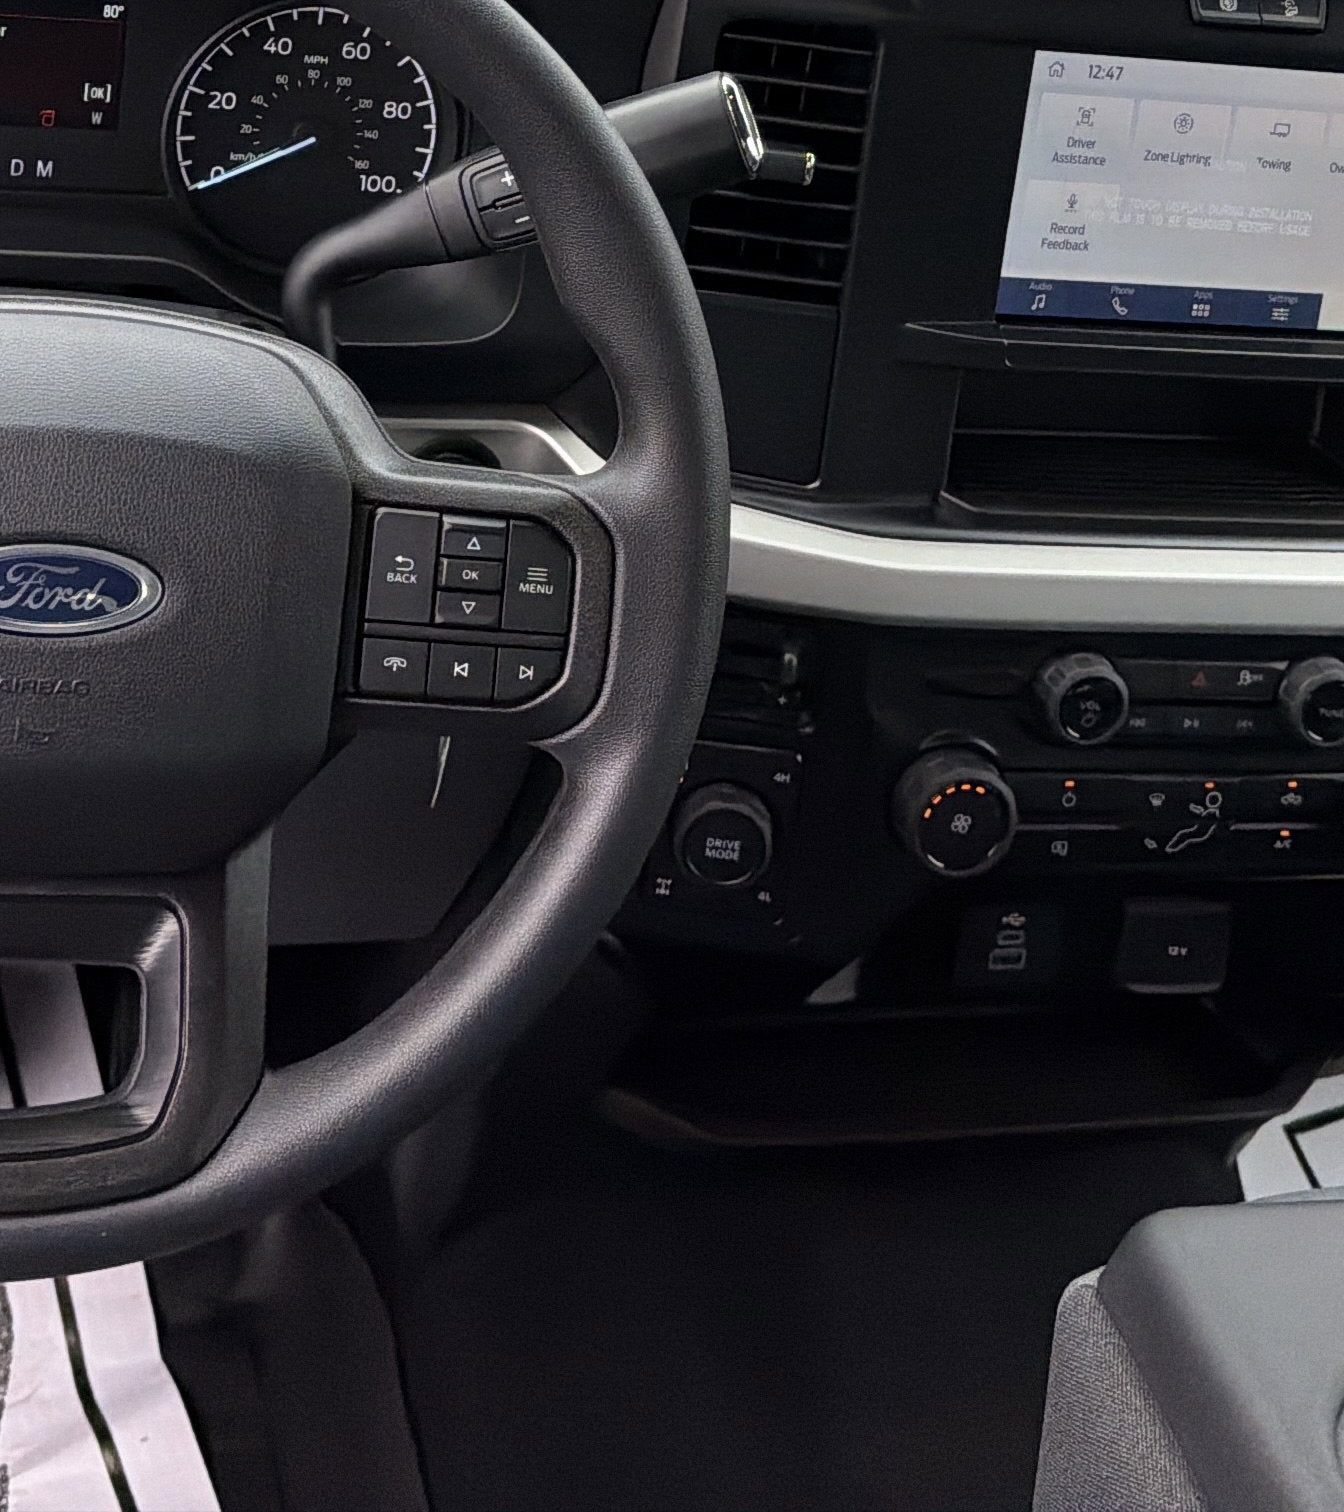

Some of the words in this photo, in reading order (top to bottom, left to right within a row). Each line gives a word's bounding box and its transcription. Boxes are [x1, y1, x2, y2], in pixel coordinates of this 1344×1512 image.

[262, 38, 294, 57] 40
[341, 42, 372, 61] 60
[303, 54, 330, 66] MPH
[307, 68, 321, 80] 80
[1087, 63, 1124, 81] 12:47
[275, 74, 289, 86] 60
[335, 75, 353, 88] 100
[207, 91, 237, 110] 20
[250, 94, 265, 106] 40
[358, 98, 374, 110] 120
[382, 101, 413, 120] 80
[90, 111, 104, 126] W
[239, 123, 253, 135] 20
[363, 129, 380, 141] 140
[1066, 136, 1097, 149] Driver
[1051, 151, 1106, 167] Assistance
[1143, 149, 1169, 163] Zone
[10, 159, 25, 177] D
[36, 160, 54, 179] M
[354, 159, 370, 171] 160
[1256, 156, 1292, 173] Towing
[359, 174, 396, 193] 100
[1050, 223, 1085, 236] Record
[1040, 238, 1090, 253] Feedback
[1028, 281, 1053, 292] Audio
[1110, 285, 1135, 296] Phone
[1193, 289, 1214, 301] Apps
[1267, 293, 1299, 305] Settings
[386, 572, 419, 585] BACK
[461, 569, 480, 580] OK
[518, 583, 554, 595] MENU
[772, 771, 791, 784] 4H
[706, 837, 742, 850] DRIVE
[704, 847, 741, 861] MODE
[757, 891, 772, 903] 4L
